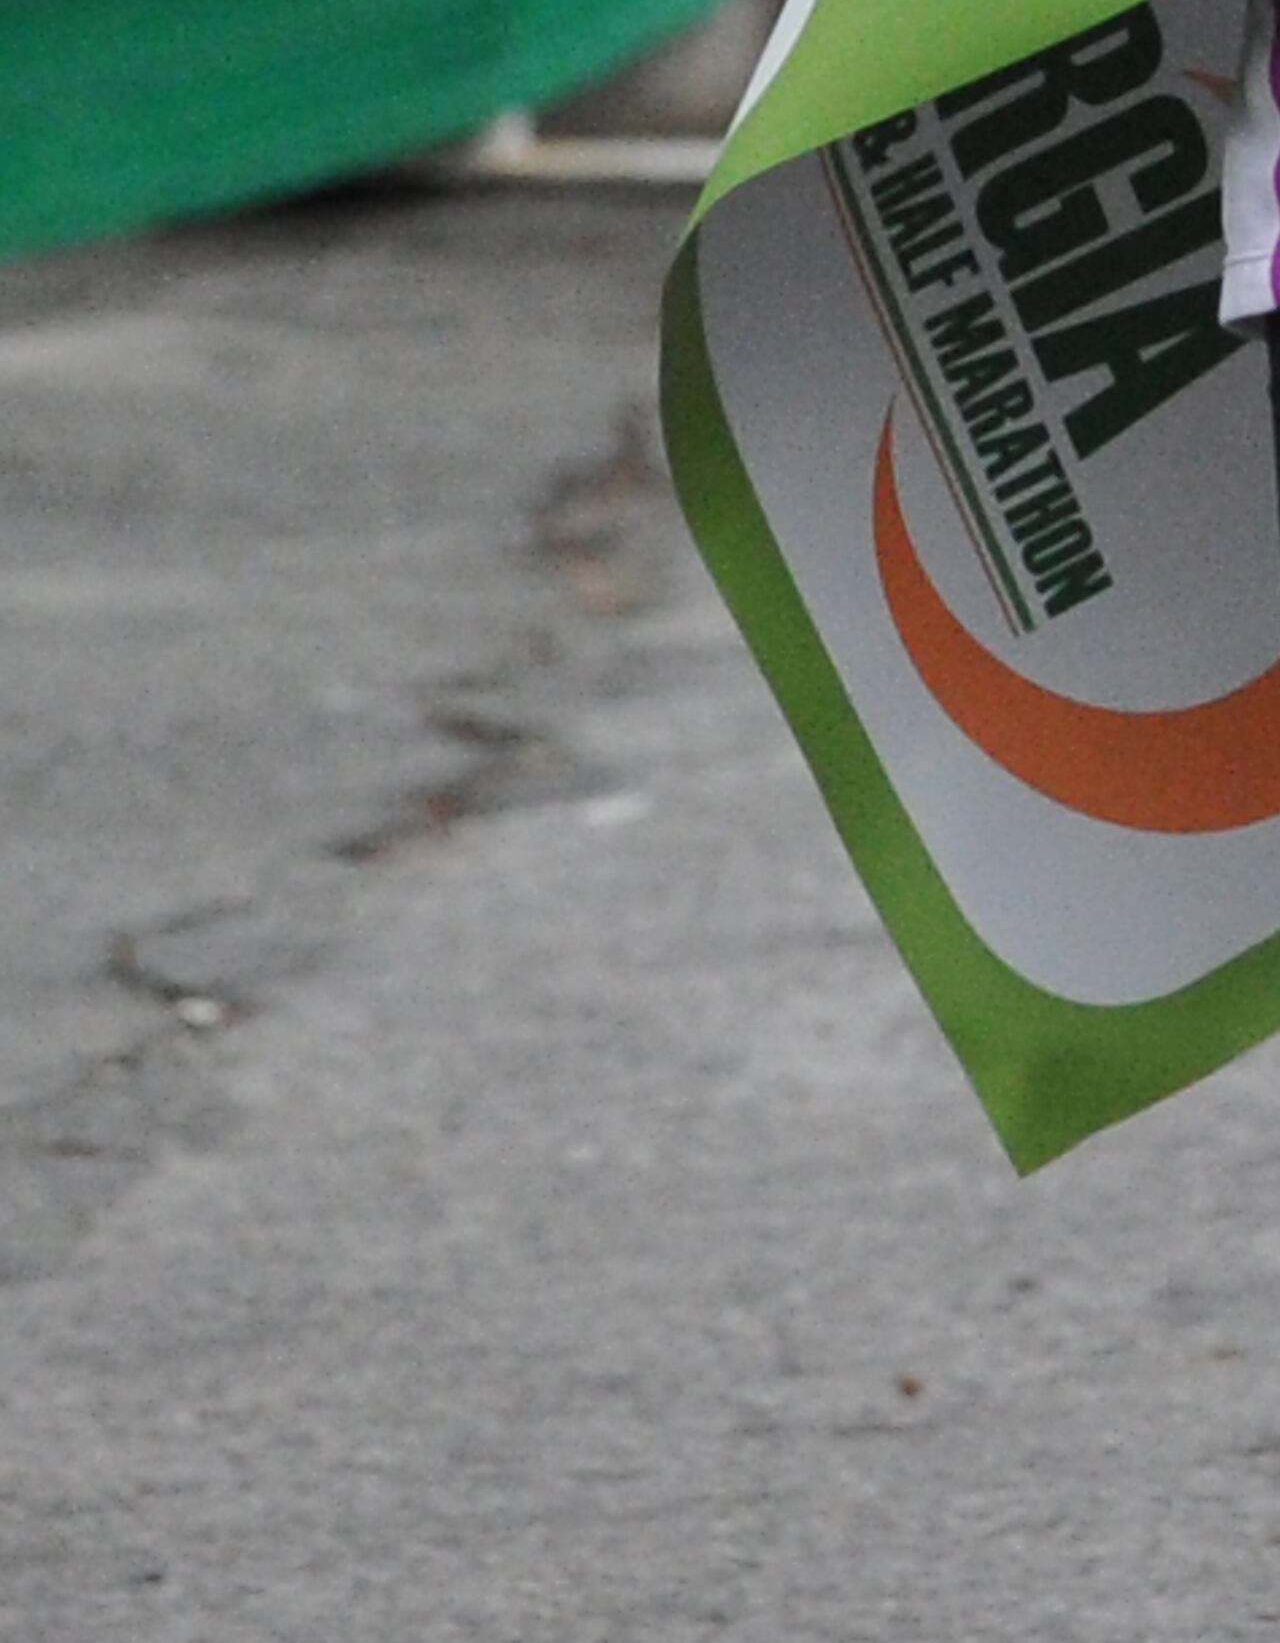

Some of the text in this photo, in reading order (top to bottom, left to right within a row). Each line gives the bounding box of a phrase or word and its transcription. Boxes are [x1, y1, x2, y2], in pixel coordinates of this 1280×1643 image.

[853, 110, 1113, 619] & HALF MARATHON
[936, 0, 1252, 463] RGIA
